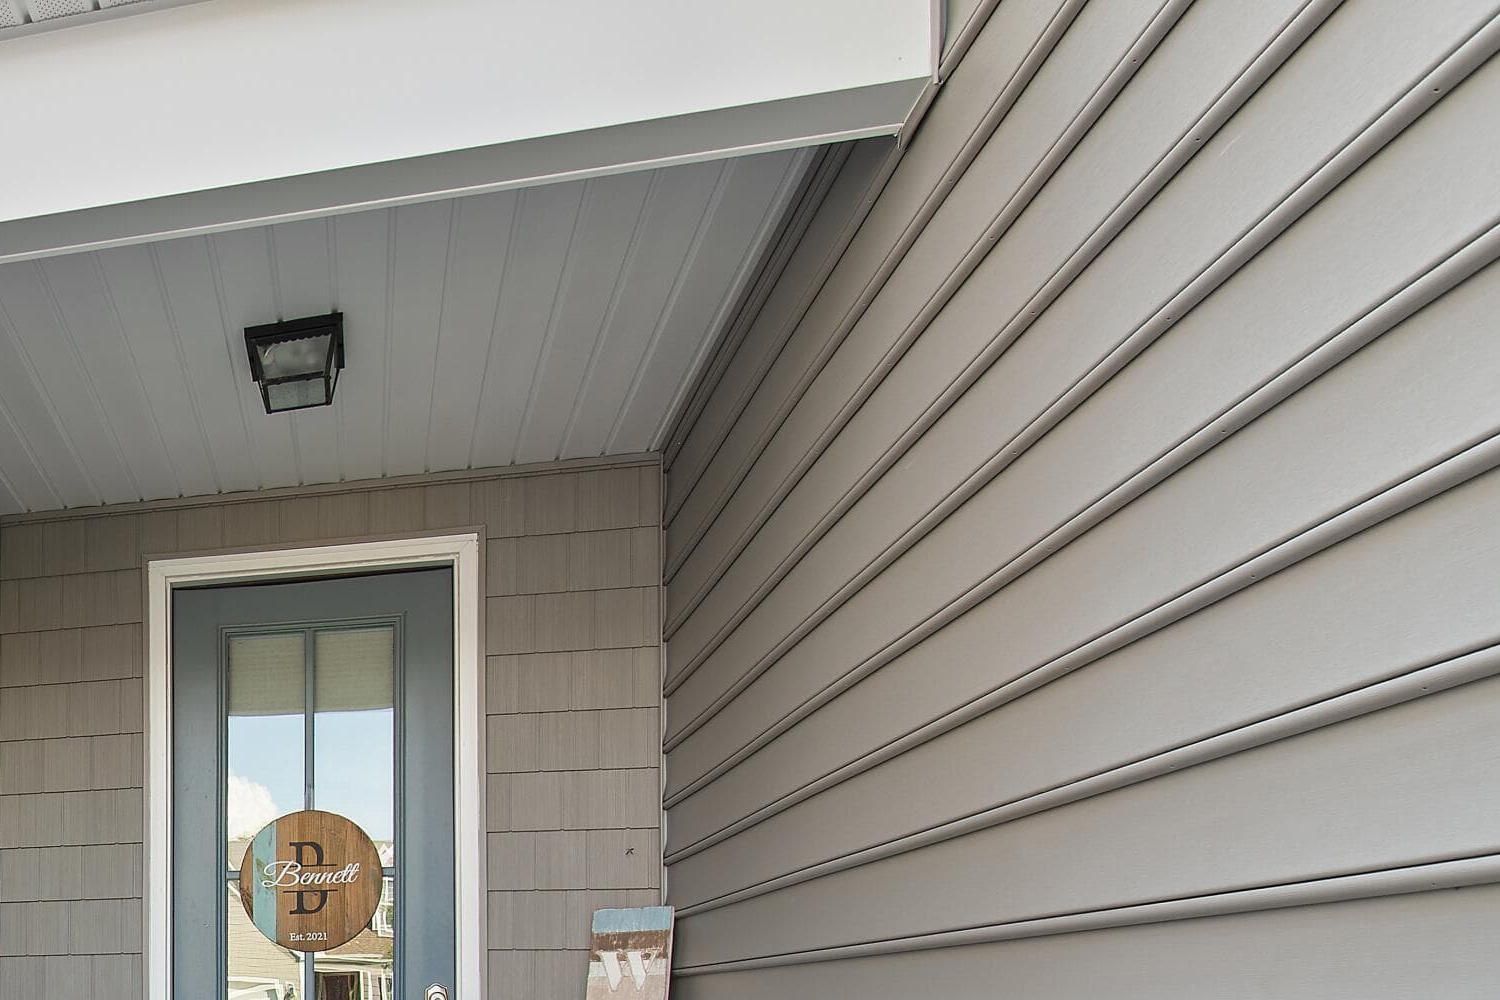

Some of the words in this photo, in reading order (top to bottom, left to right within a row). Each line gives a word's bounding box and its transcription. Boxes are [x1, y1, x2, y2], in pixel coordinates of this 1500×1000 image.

[262, 861, 360, 887] Bennett
[289, 932, 305, 942] Est.
[306, 932, 328, 941] 2021
